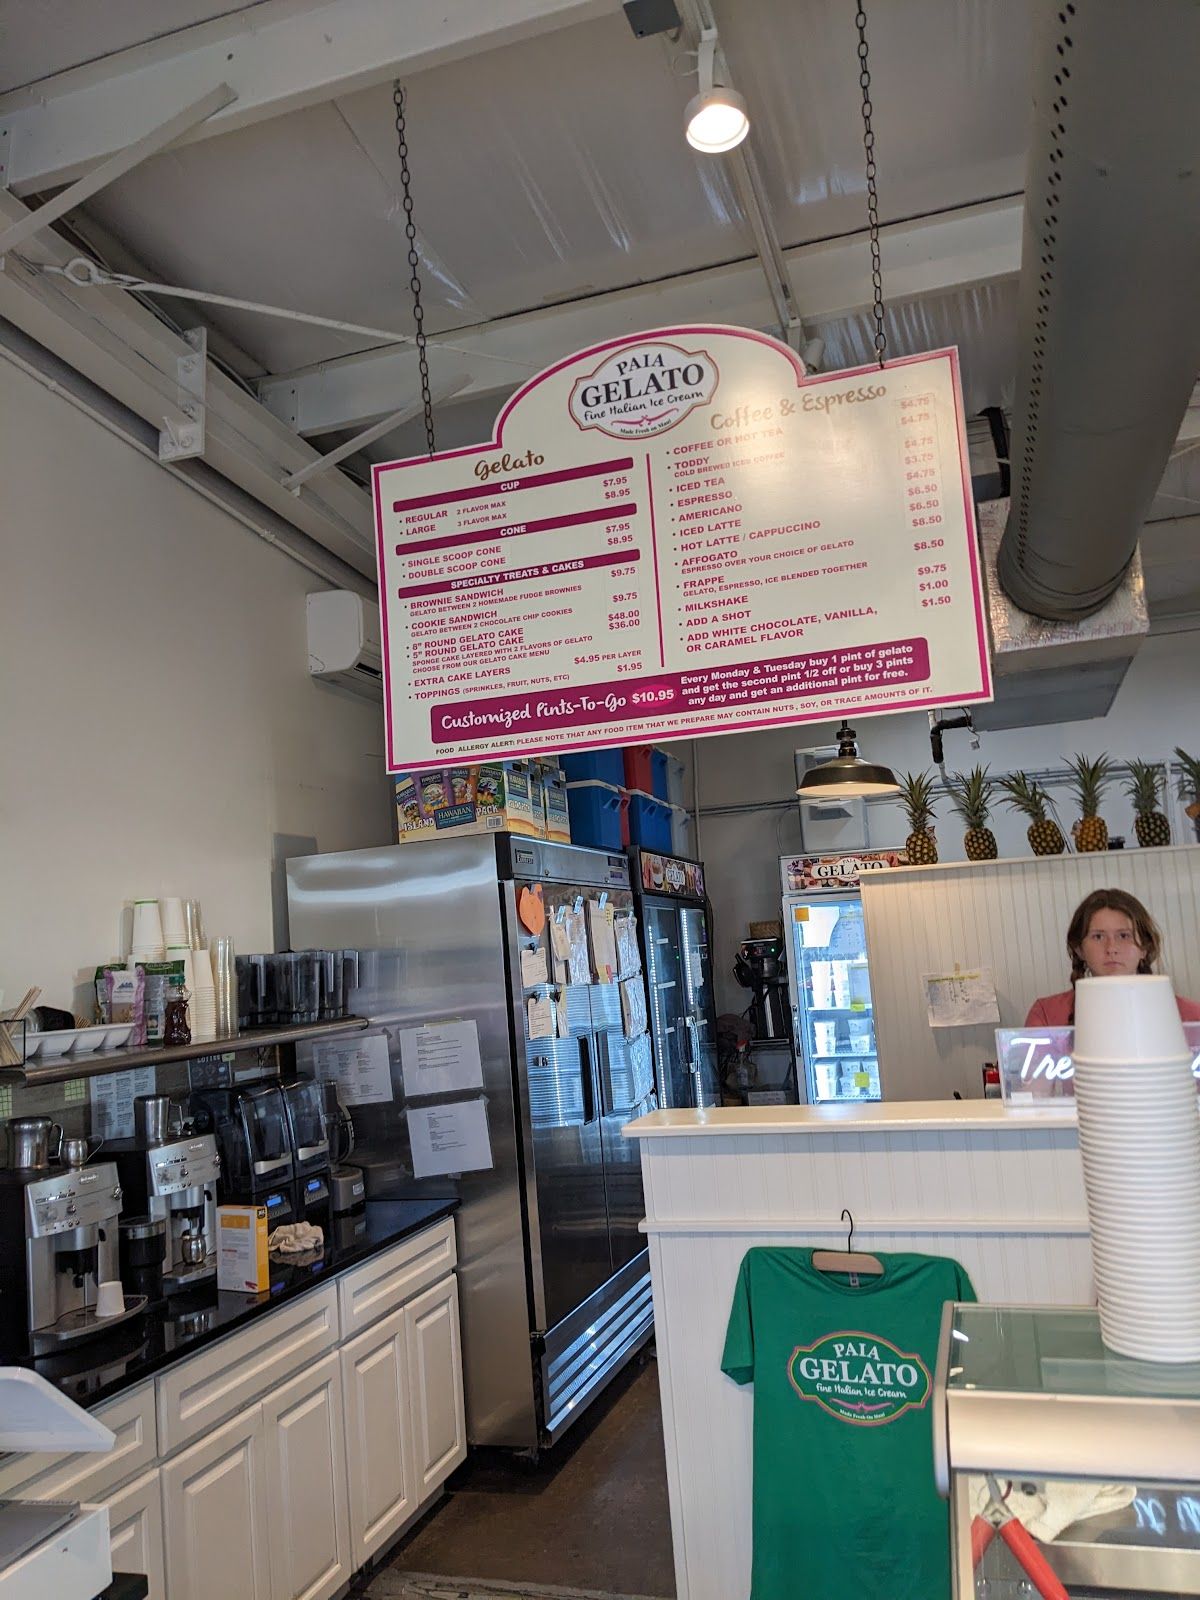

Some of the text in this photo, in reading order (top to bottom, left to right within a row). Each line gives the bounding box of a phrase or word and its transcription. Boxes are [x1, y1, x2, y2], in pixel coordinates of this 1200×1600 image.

[616, 353, 665, 376] PAIA
[581, 363, 704, 408] GELATO
[584, 391, 704, 422] Fine Italian Ice Cream
[711, 385, 886, 430] Coffee & Espresso
[673, 437, 732, 455] COFFEE OR
[474, 450, 545, 481] Gelato
[674, 456, 710, 470] TODDY
[674, 467, 695, 478] COLD
[501, 481, 520, 491] CUP
[603, 477, 627, 487] $7.95
[676, 477, 725, 493] ICED TEA
[605, 488, 630, 499] $8.95
[677, 490, 733, 507] ESPRESSO
[405, 504, 489, 524] REGULAR FLAVOR
[679, 504, 743, 522] AMERICANO
[912, 515, 942, 527] $8.50
[406, 524, 436, 536] LARGE
[463, 517, 490, 526] FLAVOR
[500, 525, 527, 536] CONE
[606, 523, 630, 534] $7.95
[680, 520, 742, 537] ICED LATTE
[607, 535, 633, 546] $8.95
[681, 521, 821, 552] HOT LATTE CAPPUCCINO
[914, 539, 944, 551] $8.50
[408, 545, 502, 568] SINGLE SCOOP CONE
[681, 540, 854, 575] ESPRESSO OVER CHOICE GELATO
[681, 550, 738, 566] AFFOGATO
[408, 557, 506, 579] DOUBLE SCOOP CONE
[451, 560, 584, 589] SPECIALTY TREATS & CAKES
[611, 567, 636, 577] $9.75
[918, 564, 947, 576] $9.75
[683, 575, 725, 589] FRAPPE
[719, 579, 763, 592] ESPRESSO,
[781, 569, 819, 582] BLENDED
[822, 562, 868, 574] TOGETHER
[919, 579, 949, 591] $1.00
[410, 588, 504, 610] BROWNIE SANDWICH
[438, 585, 582, 613] BETWEEN HOMEMADE BROWNIES
[612, 592, 638, 602] $9.75
[685, 595, 749, 612] MILKSHAKE
[921, 596, 951, 608] $1.50
[411, 611, 497, 630] COOKIE SANDWICH
[439, 608, 573, 633] BETWEEN CHOCOLATE COOKIES
[608, 610, 640, 621] $48.00
[686, 617, 708, 627] ADD
[722, 610, 751, 621] SHOT
[609, 619, 640, 630] $36.00
[687, 607, 878, 642] ADD WHITE CHOCOLATE, VANILLA,
[424, 628, 524, 649] ROUND GELATO CAKE
[425, 636, 524, 657] ROUND GELATO CAKE
[686, 629, 804, 653] OR CARAMEL FLAVOR
[414, 654, 600, 687] EXTRA CAKE LAYERS $4.95
[617, 662, 642, 672] $1.95
[680, 645, 913, 685] Every Monday & Tuesday buy 1 pint of gelato
[682, 656, 914, 695] and get the second pint 1/2 off or buy 3 pints
[414, 687, 460, 700] TOPPINGS
[688, 669, 909, 706] any day and get an additional pint for free.
[632, 689, 674, 704] $10.95
[441, 693, 627, 729] Customized Pints-To-Go
[476, 805, 499, 817] PACK
[404, 817, 435, 832] ISLAND
[818, 862, 883, 877] GELATO
[833, 1342, 881, 1361] PAIA
[800, 1357, 918, 1387] GELATO
[816, 1382, 907, 1399] Fine Italian Ice Cream
